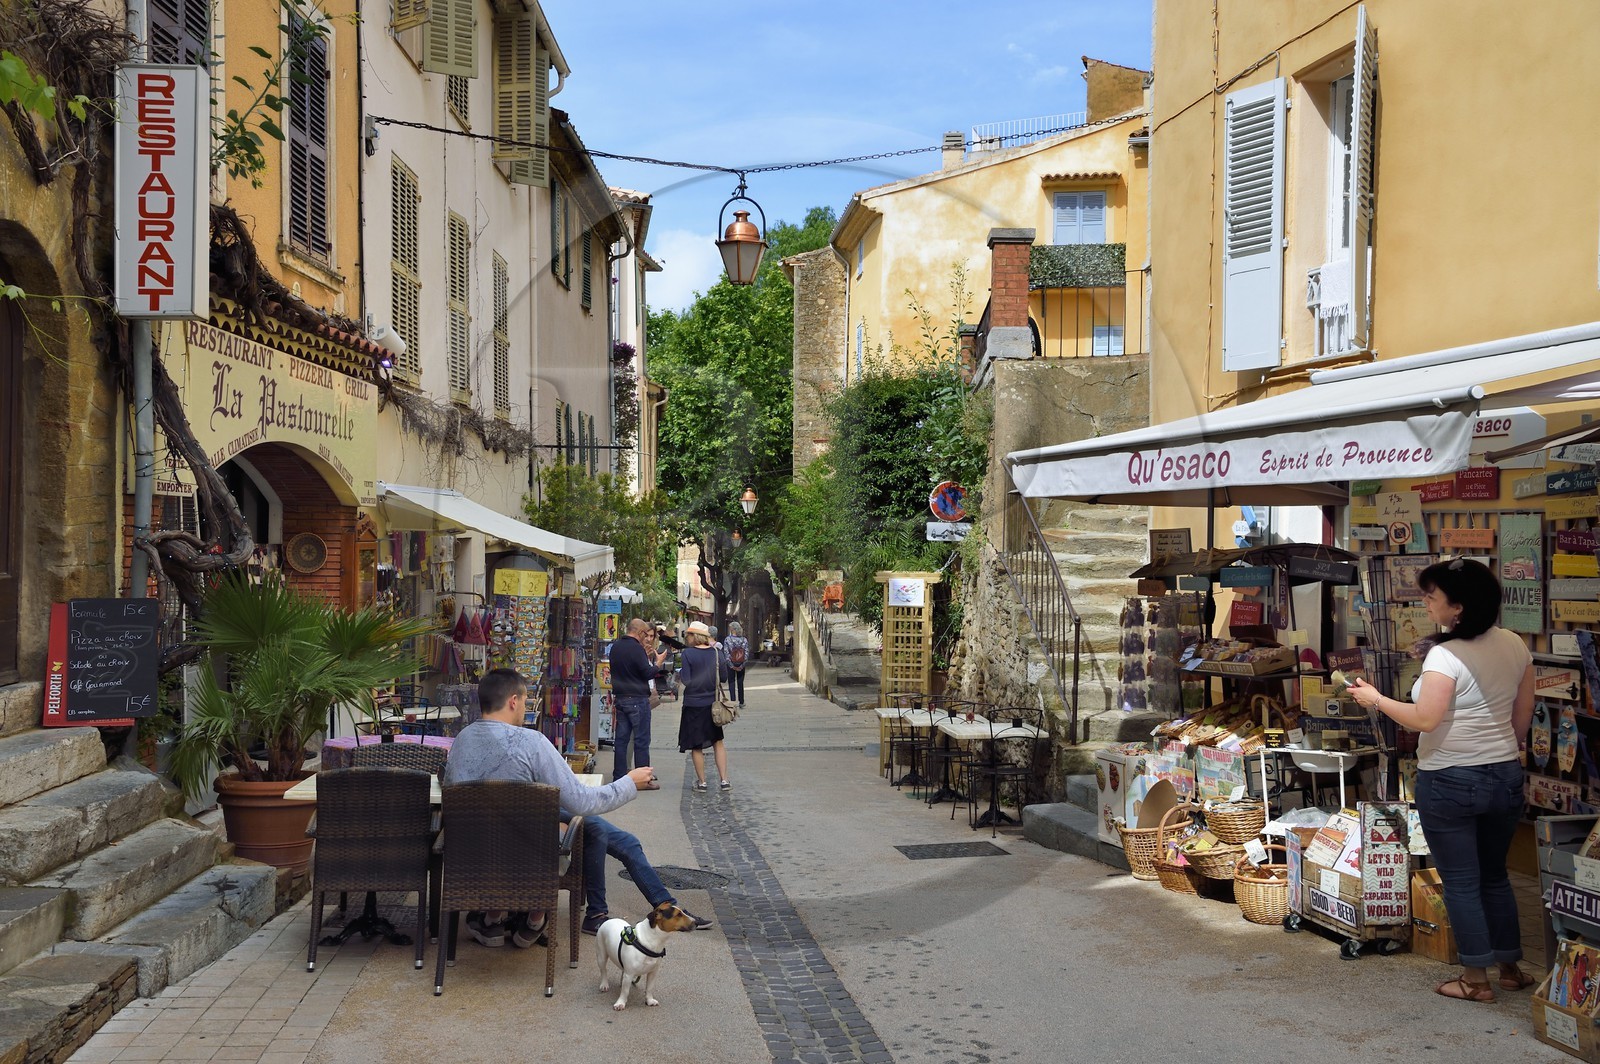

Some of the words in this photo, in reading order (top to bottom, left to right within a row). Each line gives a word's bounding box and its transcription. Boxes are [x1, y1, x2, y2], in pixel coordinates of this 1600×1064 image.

[137, 73, 176, 312] RESTAURANT
[187, 320, 275, 370] RESTAURANT
[289, 357, 334, 390] PIZZERIA
[345, 377, 370, 401] GRILL
[210, 360, 244, 433] La
[258, 375, 355, 441] Pastourelle
[1127, 448, 1231, 486] Qu'esaco
[1259, 449, 1309, 476] Esprit
[1313, 447, 1334, 468] de
[1343, 440, 1434, 468] Provence
[1458, 468, 1493, 480] Pancartes
[156, 481, 193, 494] EMPORTER
[1559, 534, 1571, 544] Bar
[1501, 586, 1534, 606] WAVE
[70, 630, 101, 645] Pizza
[48, 673, 63, 715] PELFORTH
[1552, 784, 1571, 793] CAVE
[1367, 853, 1391, 864] LET'S
[1393, 853, 1404, 864] GO
[1376, 867, 1395, 877] WILD
[1379, 880, 1393, 889] AND
[1364, 891, 1393, 901] EXPLORE
[1394, 891, 1408, 901] THE
[1311, 890, 1329, 912] GOOD
[1337, 902, 1356, 924] BEER
[1366, 904, 1407, 917] WORLD!
